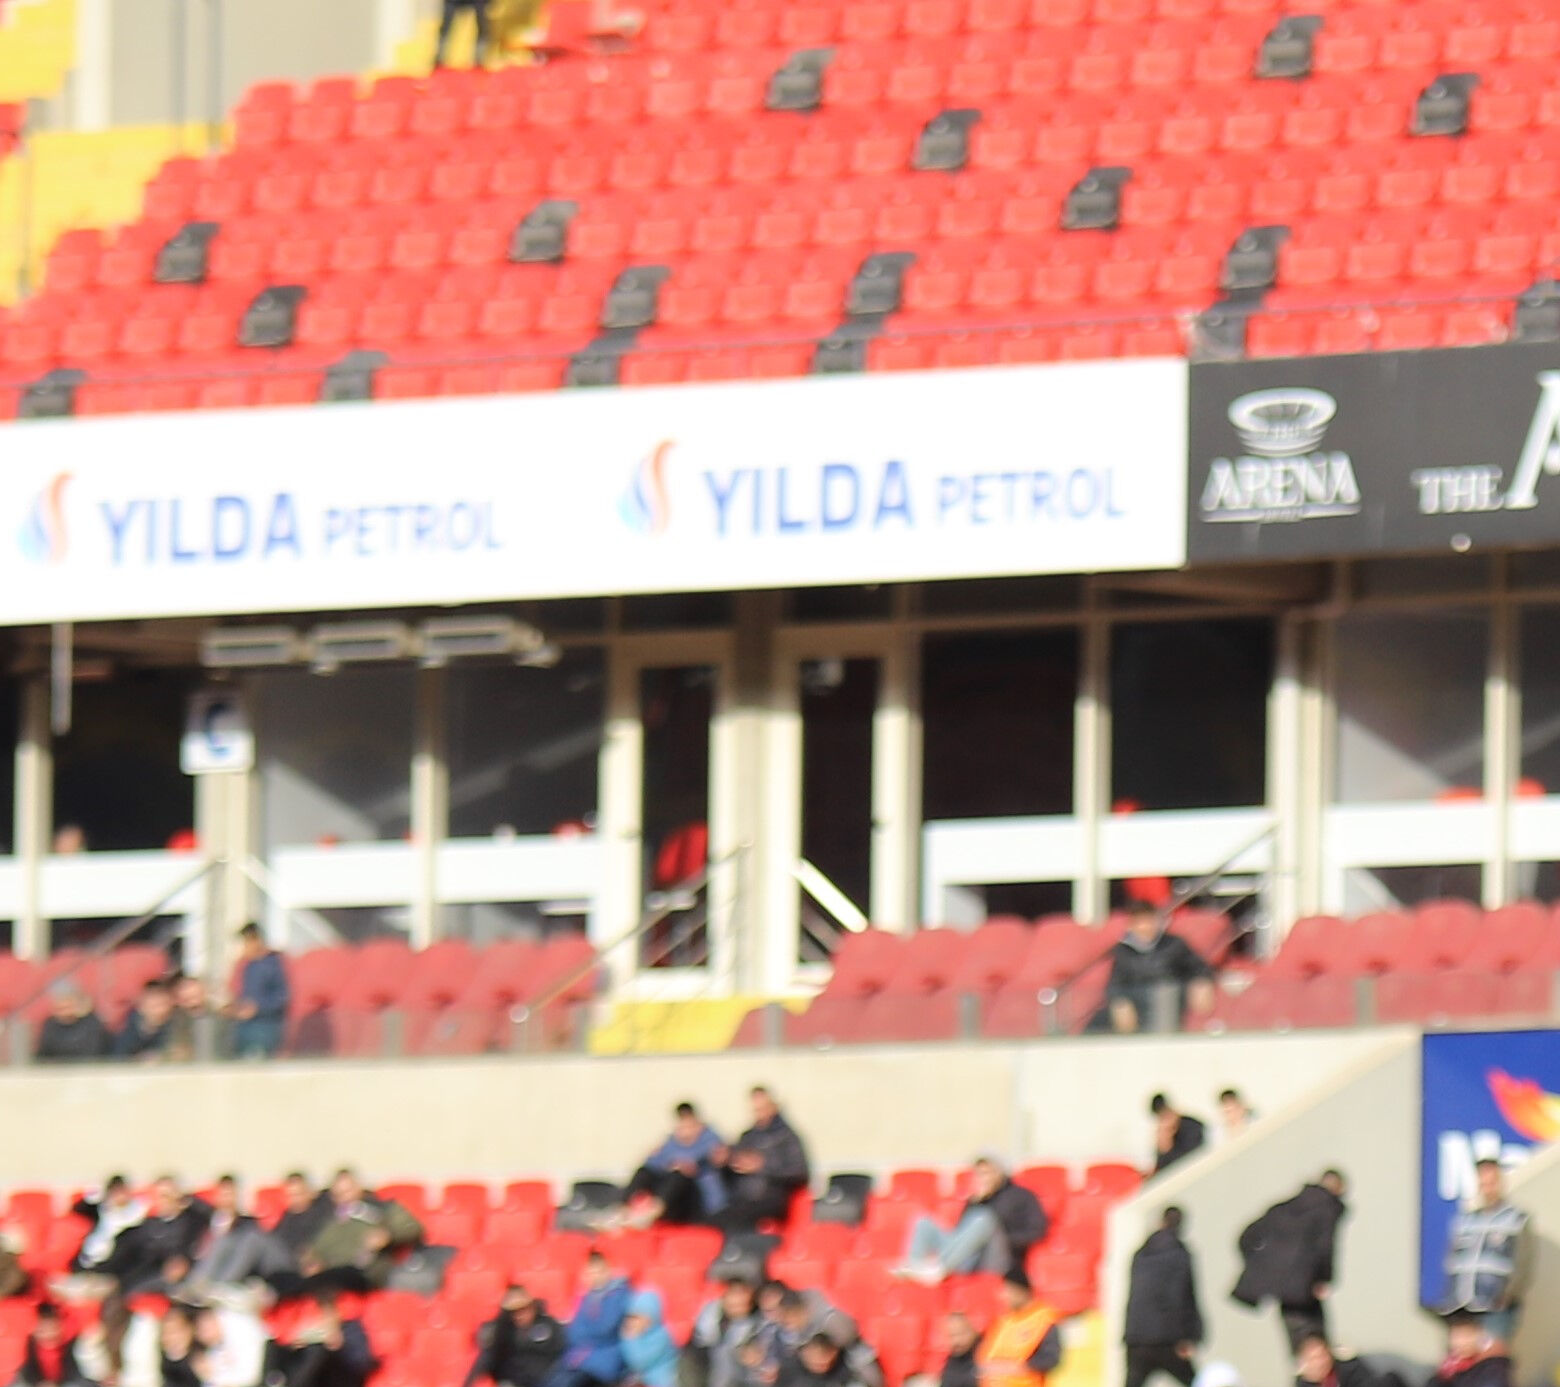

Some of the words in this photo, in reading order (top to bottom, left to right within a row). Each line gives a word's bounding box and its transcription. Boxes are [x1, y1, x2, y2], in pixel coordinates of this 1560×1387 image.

[703, 459, 917, 539] YILDA
[936, 466, 1127, 527] PETROL
[1200, 450, 1362, 513] ARENA
[1410, 464, 1504, 514] THE
[100, 492, 303, 565] YILDA
[323, 498, 507, 557] PETROL
